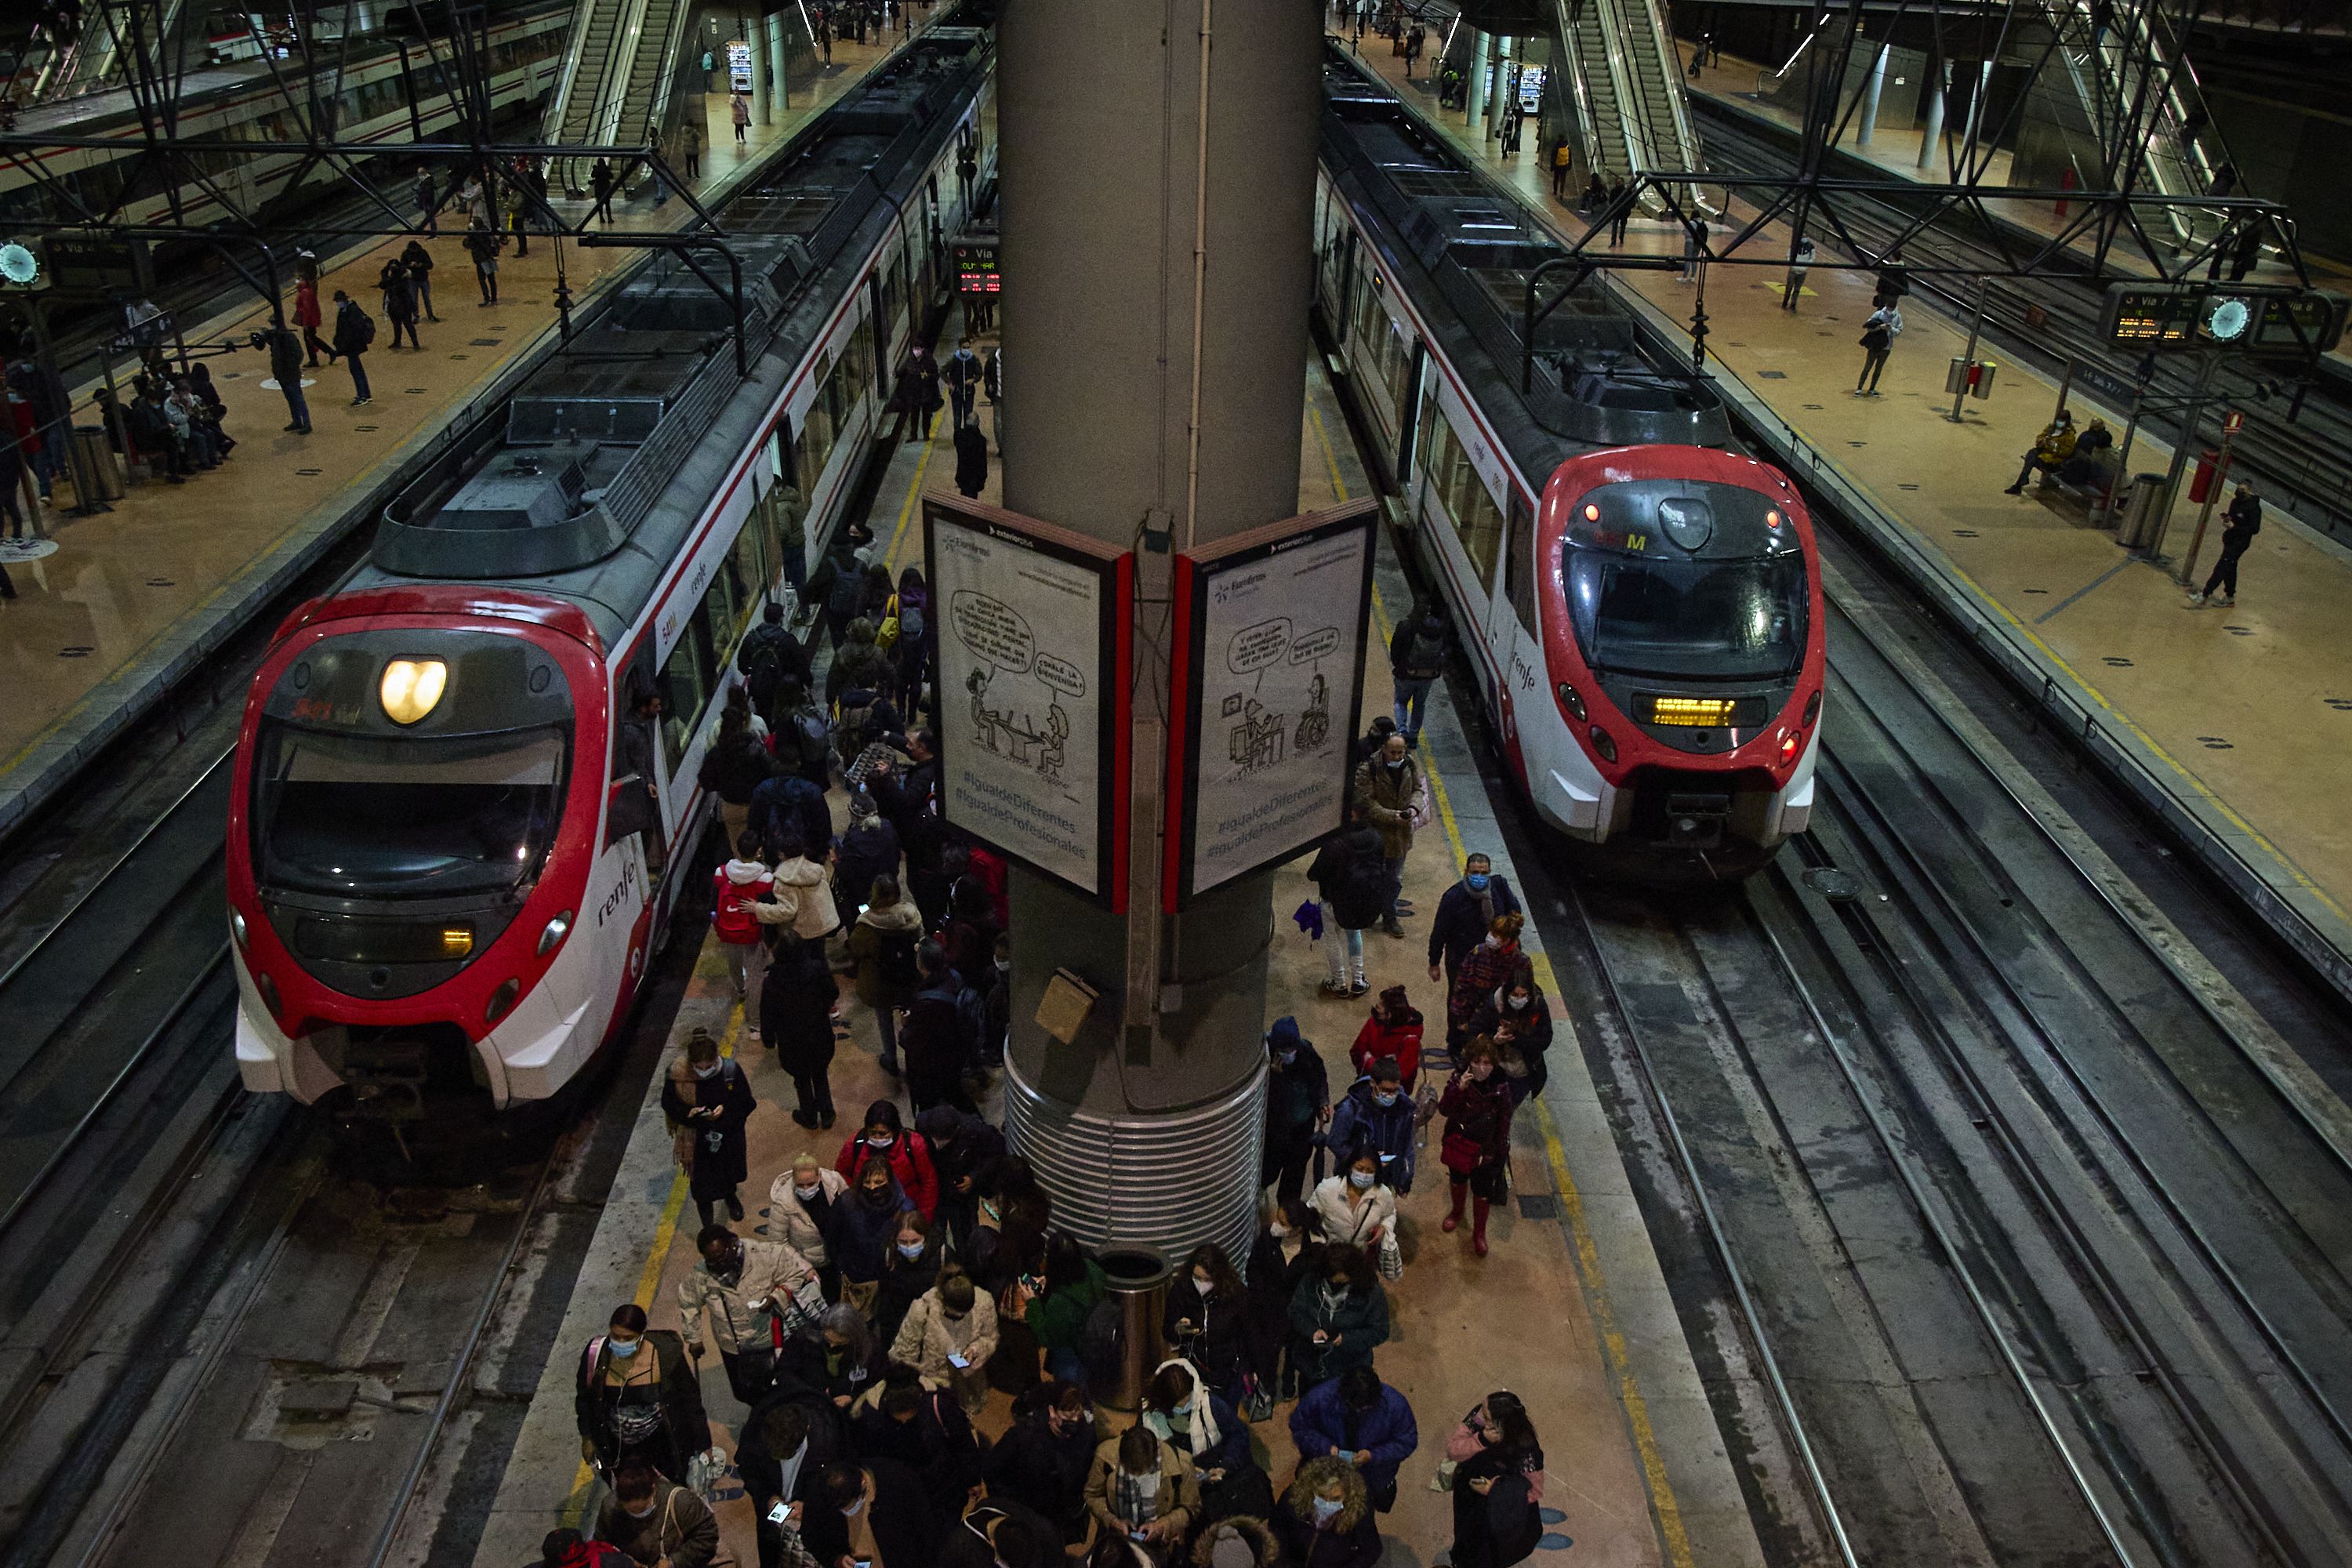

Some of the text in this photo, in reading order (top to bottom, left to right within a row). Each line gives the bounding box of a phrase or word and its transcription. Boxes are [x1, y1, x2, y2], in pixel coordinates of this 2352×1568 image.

[2161, 296, 2169, 307] 7
[1510, 652, 1535, 691] renfe
[955, 786, 1087, 859] #IgualdeProfesionales
[964, 770, 1076, 834] #IgualdeDiferentes
[1207, 794, 1333, 858] #IgualdeProfesionales
[598, 859, 635, 927] renfe
